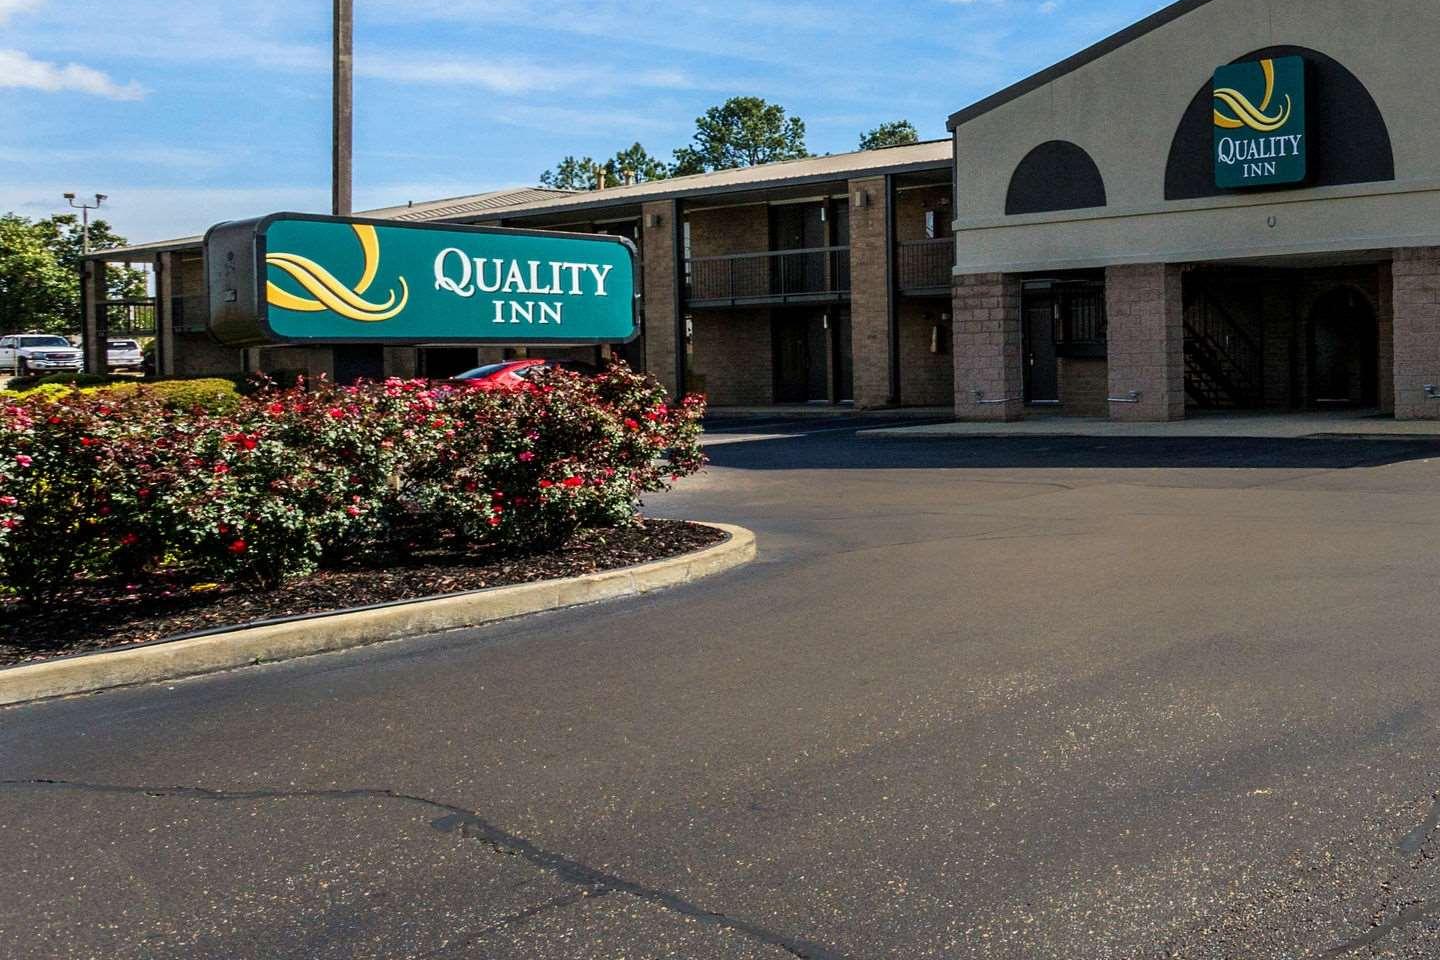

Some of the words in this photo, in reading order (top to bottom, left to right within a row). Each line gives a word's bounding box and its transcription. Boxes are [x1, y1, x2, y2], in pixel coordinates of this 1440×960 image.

[1218, 134, 1302, 164] QUALITY
[1243, 161, 1276, 177] INN
[434, 247, 613, 297] QUALITY
[492, 300, 562, 324] INN
